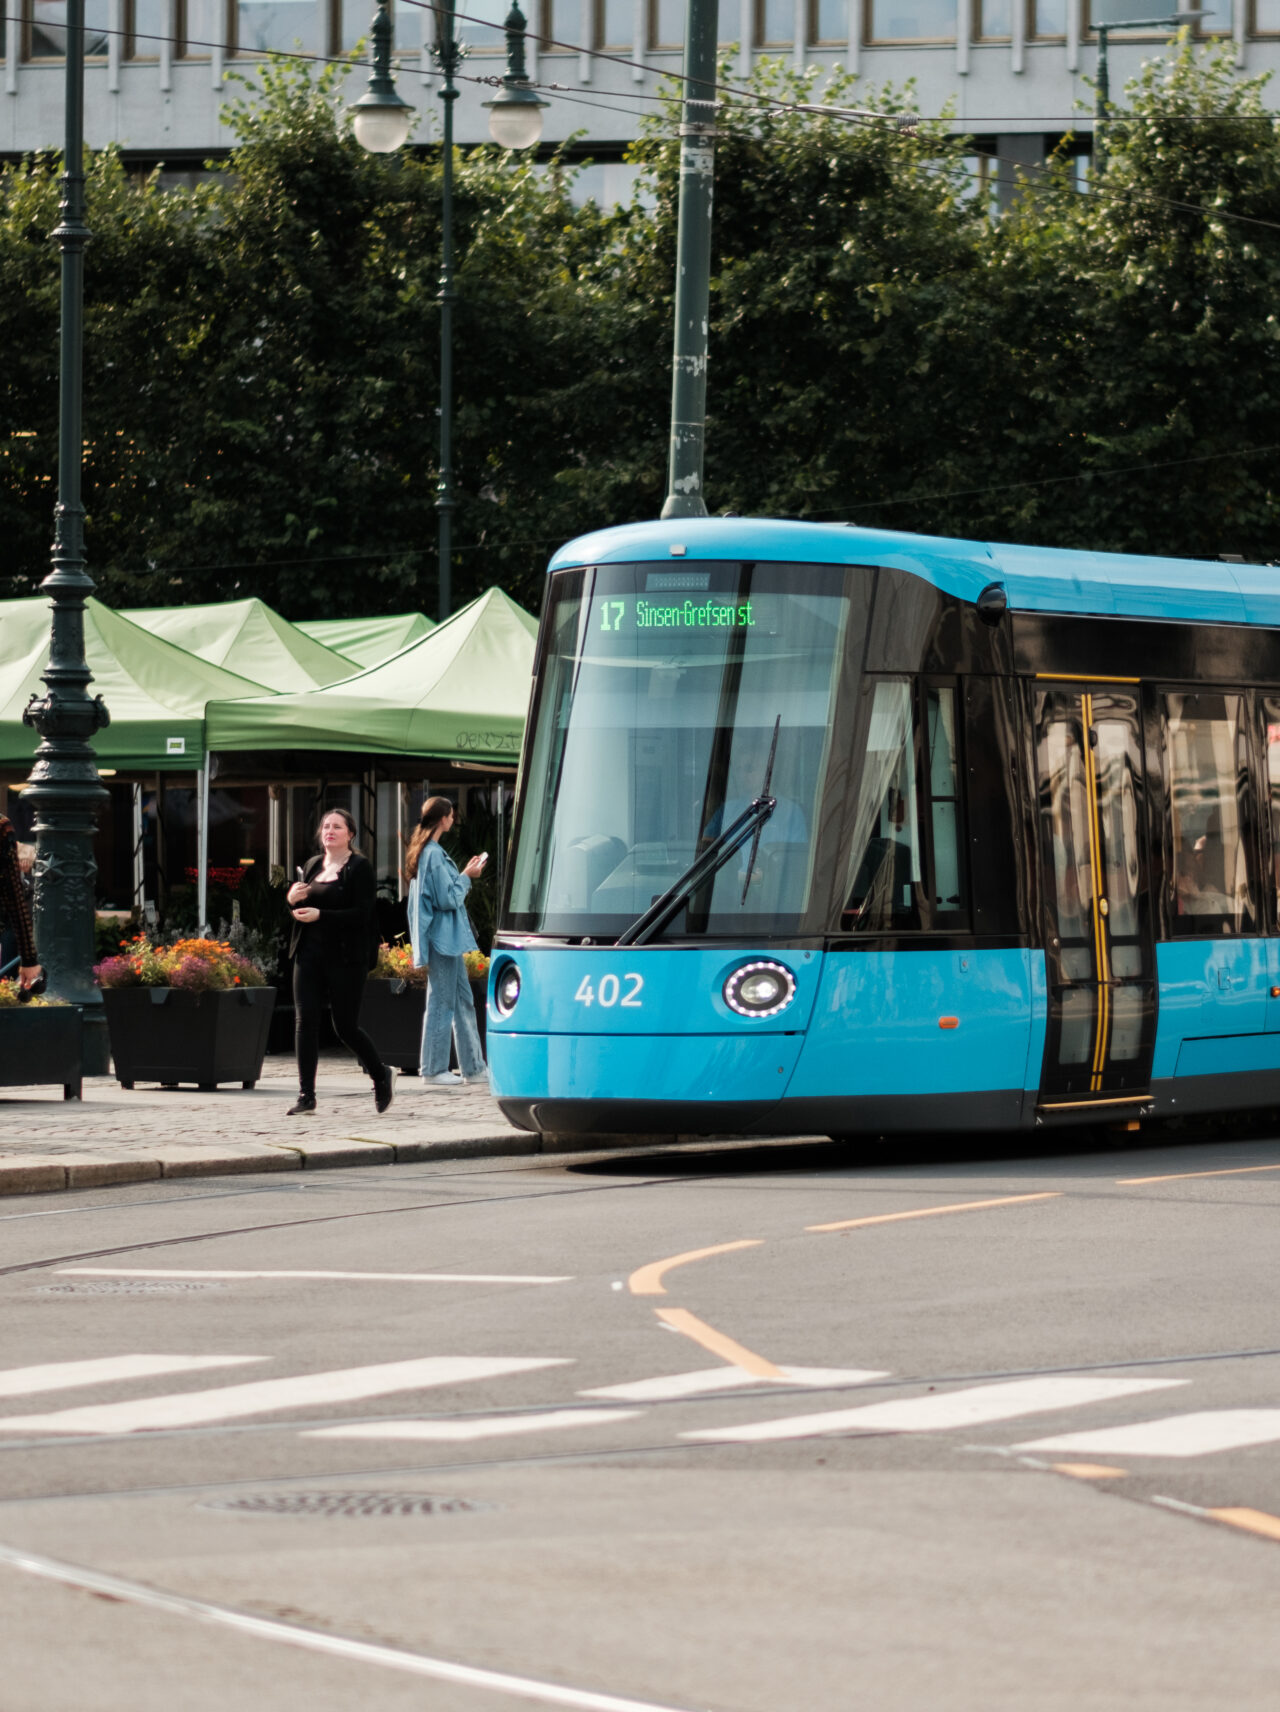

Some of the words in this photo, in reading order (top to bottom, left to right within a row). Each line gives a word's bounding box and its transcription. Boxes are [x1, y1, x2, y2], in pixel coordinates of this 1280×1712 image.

[600, 601, 625, 631] 17
[636, 600, 735, 628] Sinsen-Grefsen
[737, 601, 756, 627] st.
[574, 972, 644, 1008] 402
